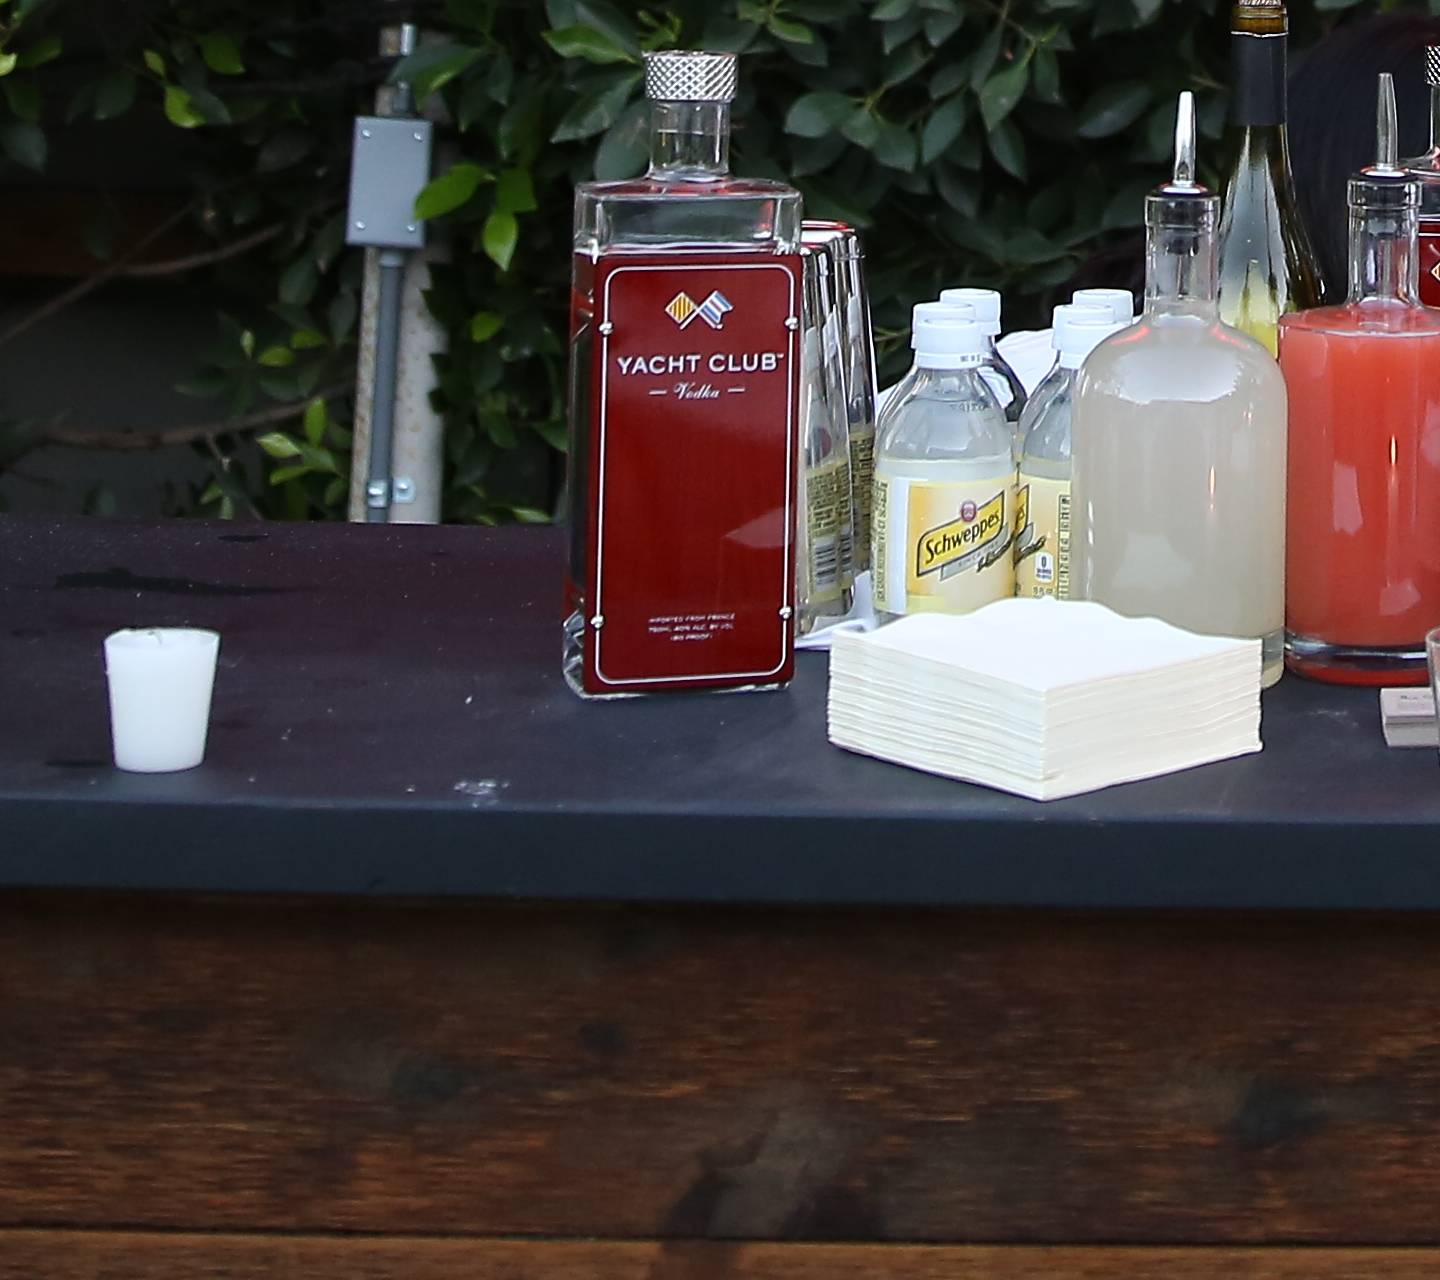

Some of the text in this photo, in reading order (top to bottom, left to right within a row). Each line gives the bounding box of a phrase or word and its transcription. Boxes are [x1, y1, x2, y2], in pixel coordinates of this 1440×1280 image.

[617, 353, 701, 375] YACHT
[673, 381, 721, 401] Vodka
[925, 508, 1001, 566] Schweppes
